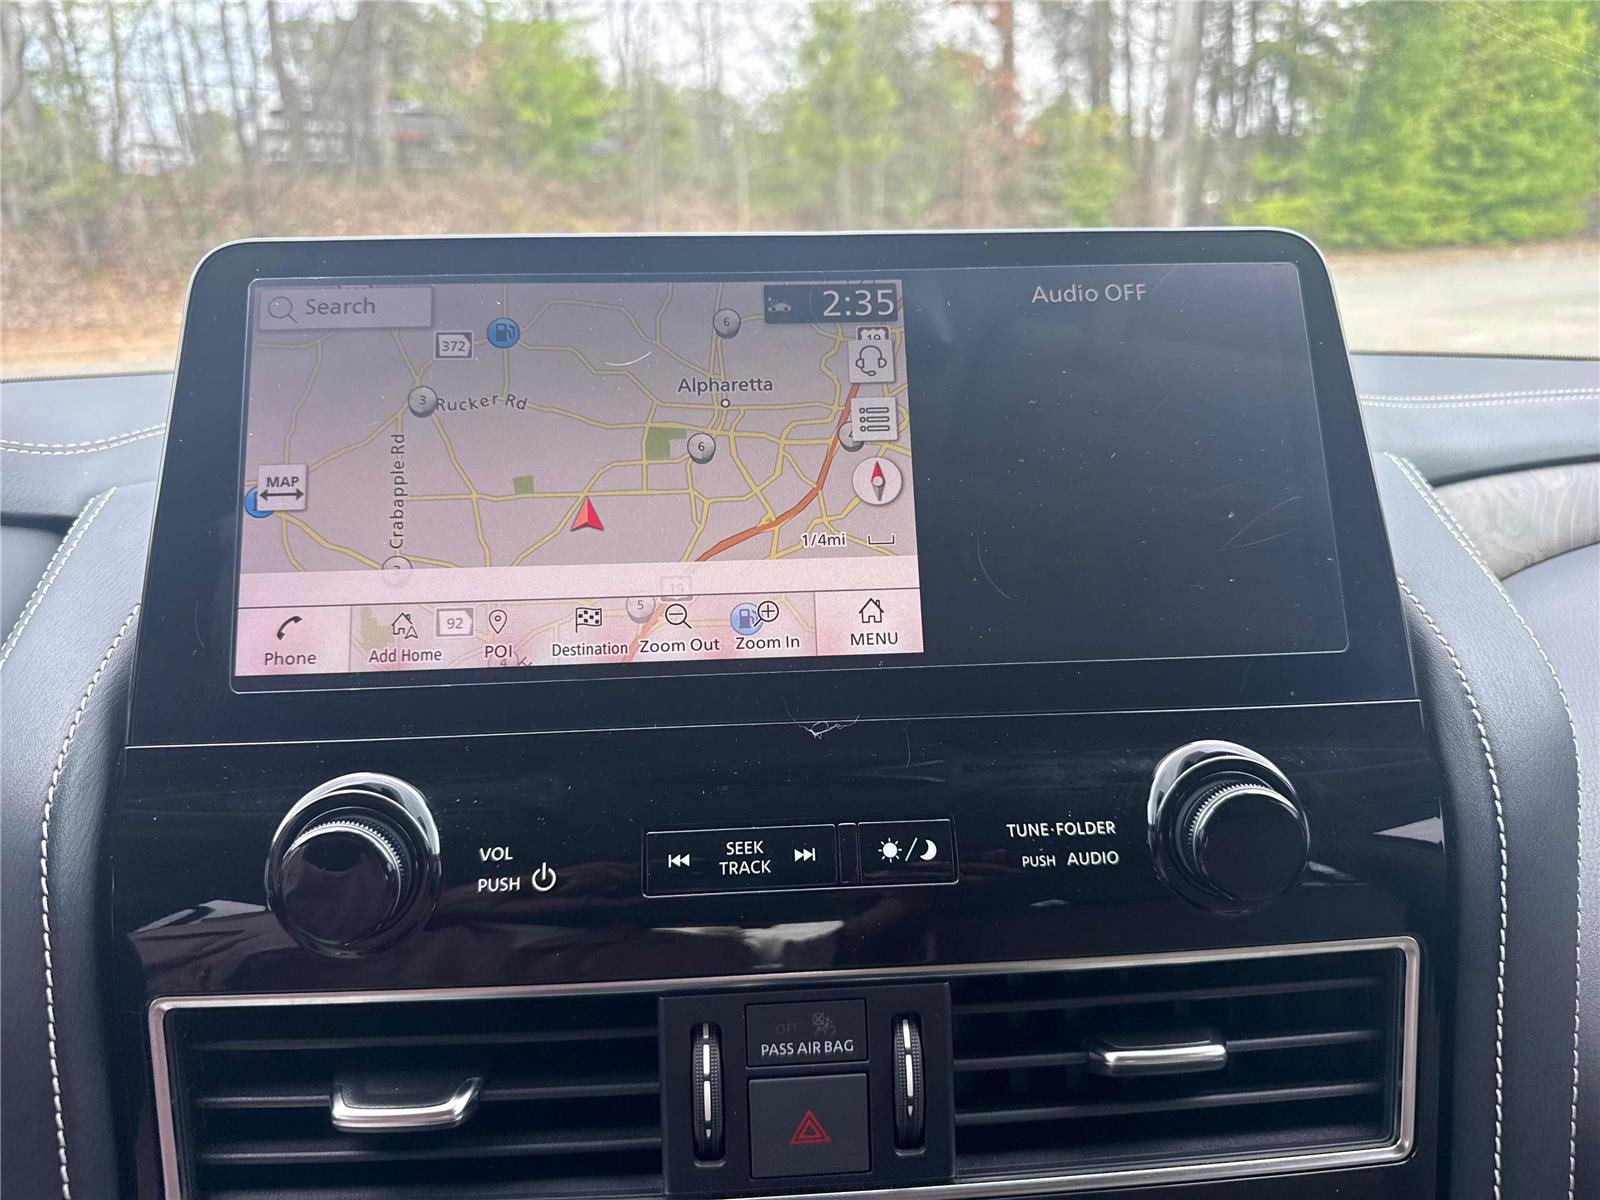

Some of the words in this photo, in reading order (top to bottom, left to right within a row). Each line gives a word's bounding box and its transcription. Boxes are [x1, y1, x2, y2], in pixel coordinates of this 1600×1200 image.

[1031, 284, 1098, 303] Audio
[1105, 284, 1146, 301] OFF
[305, 297, 376, 315] Search
[823, 289, 895, 317] 2:35
[722, 317, 731, 327] 6
[442, 340, 466, 352] 372
[678, 377, 774, 396] Alpharetta
[419, 395, 427, 406] 3
[435, 394, 499, 411] Rucker
[505, 393, 528, 410] Rd
[390, 434, 405, 455] Rd
[698, 441, 706, 452] 6
[266, 475, 299, 488] MAP
[389, 460, 408, 549] Crabapple
[801, 533, 847, 548] 1/4mi
[637, 599, 645, 610] 5
[447, 618, 464, 630] 92
[640, 639, 686, 653] Zoom
[690, 638, 721, 651] Out
[735, 636, 781, 650] Zoom
[785, 635, 801, 649] In
[850, 632, 899, 646] MENU
[369, 648, 397, 663] Add
[401, 647, 442, 662] Home
[485, 645, 513, 659] POI
[552, 642, 629, 657] Destination
[264, 651, 317, 666] Phone
[479, 846, 514, 862] VOL
[726, 840, 764, 855] SEEK
[1022, 855, 1056, 868] PUSH
[1067, 850, 1120, 867] AUDIO
[719, 860, 772, 875] TRACK
[477, 877, 521, 893] PUSH
[776, 1022, 799, 1035] OFF
[761, 1042, 795, 1056] PASS
[797, 1040, 821, 1055] AIR
[824, 1039, 854, 1053] BAG
